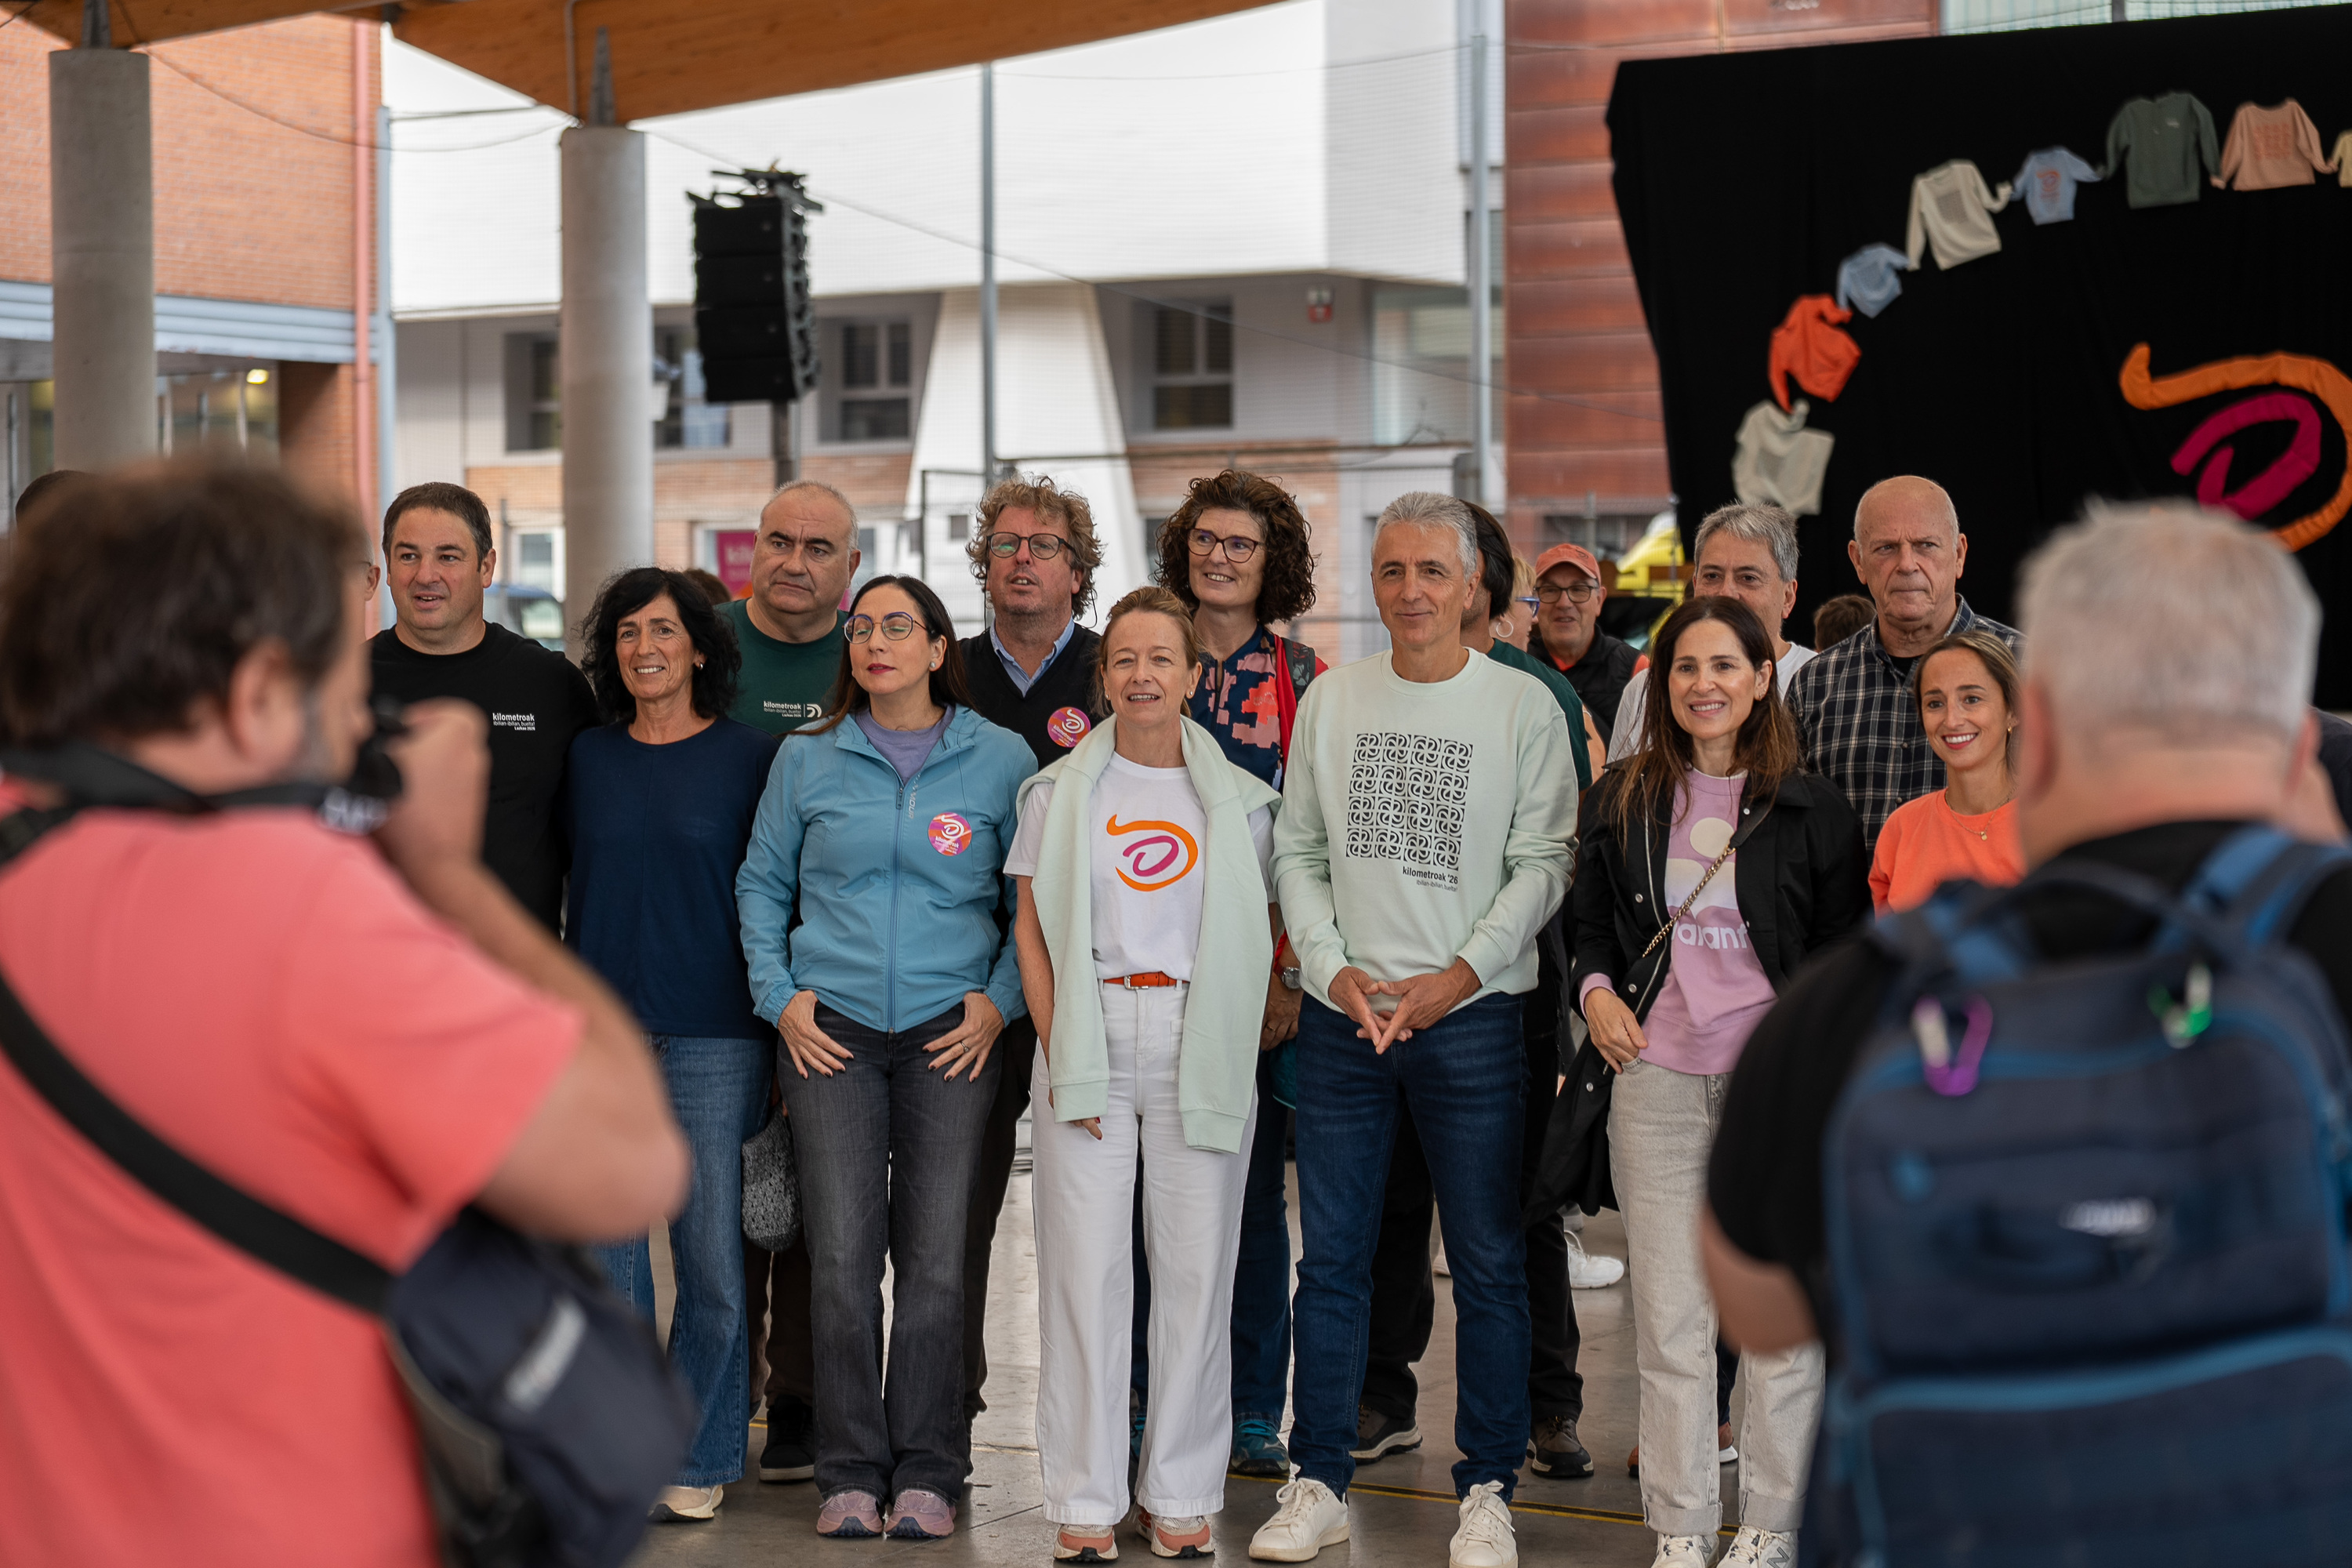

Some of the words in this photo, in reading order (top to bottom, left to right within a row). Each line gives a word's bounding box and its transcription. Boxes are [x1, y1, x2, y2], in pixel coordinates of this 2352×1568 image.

[764, 701, 801, 710] kilometroak
[492, 713, 535, 721] kilometroak
[1403, 866, 1446, 882] kilometroak
[1447, 874, 1458, 884] '26
